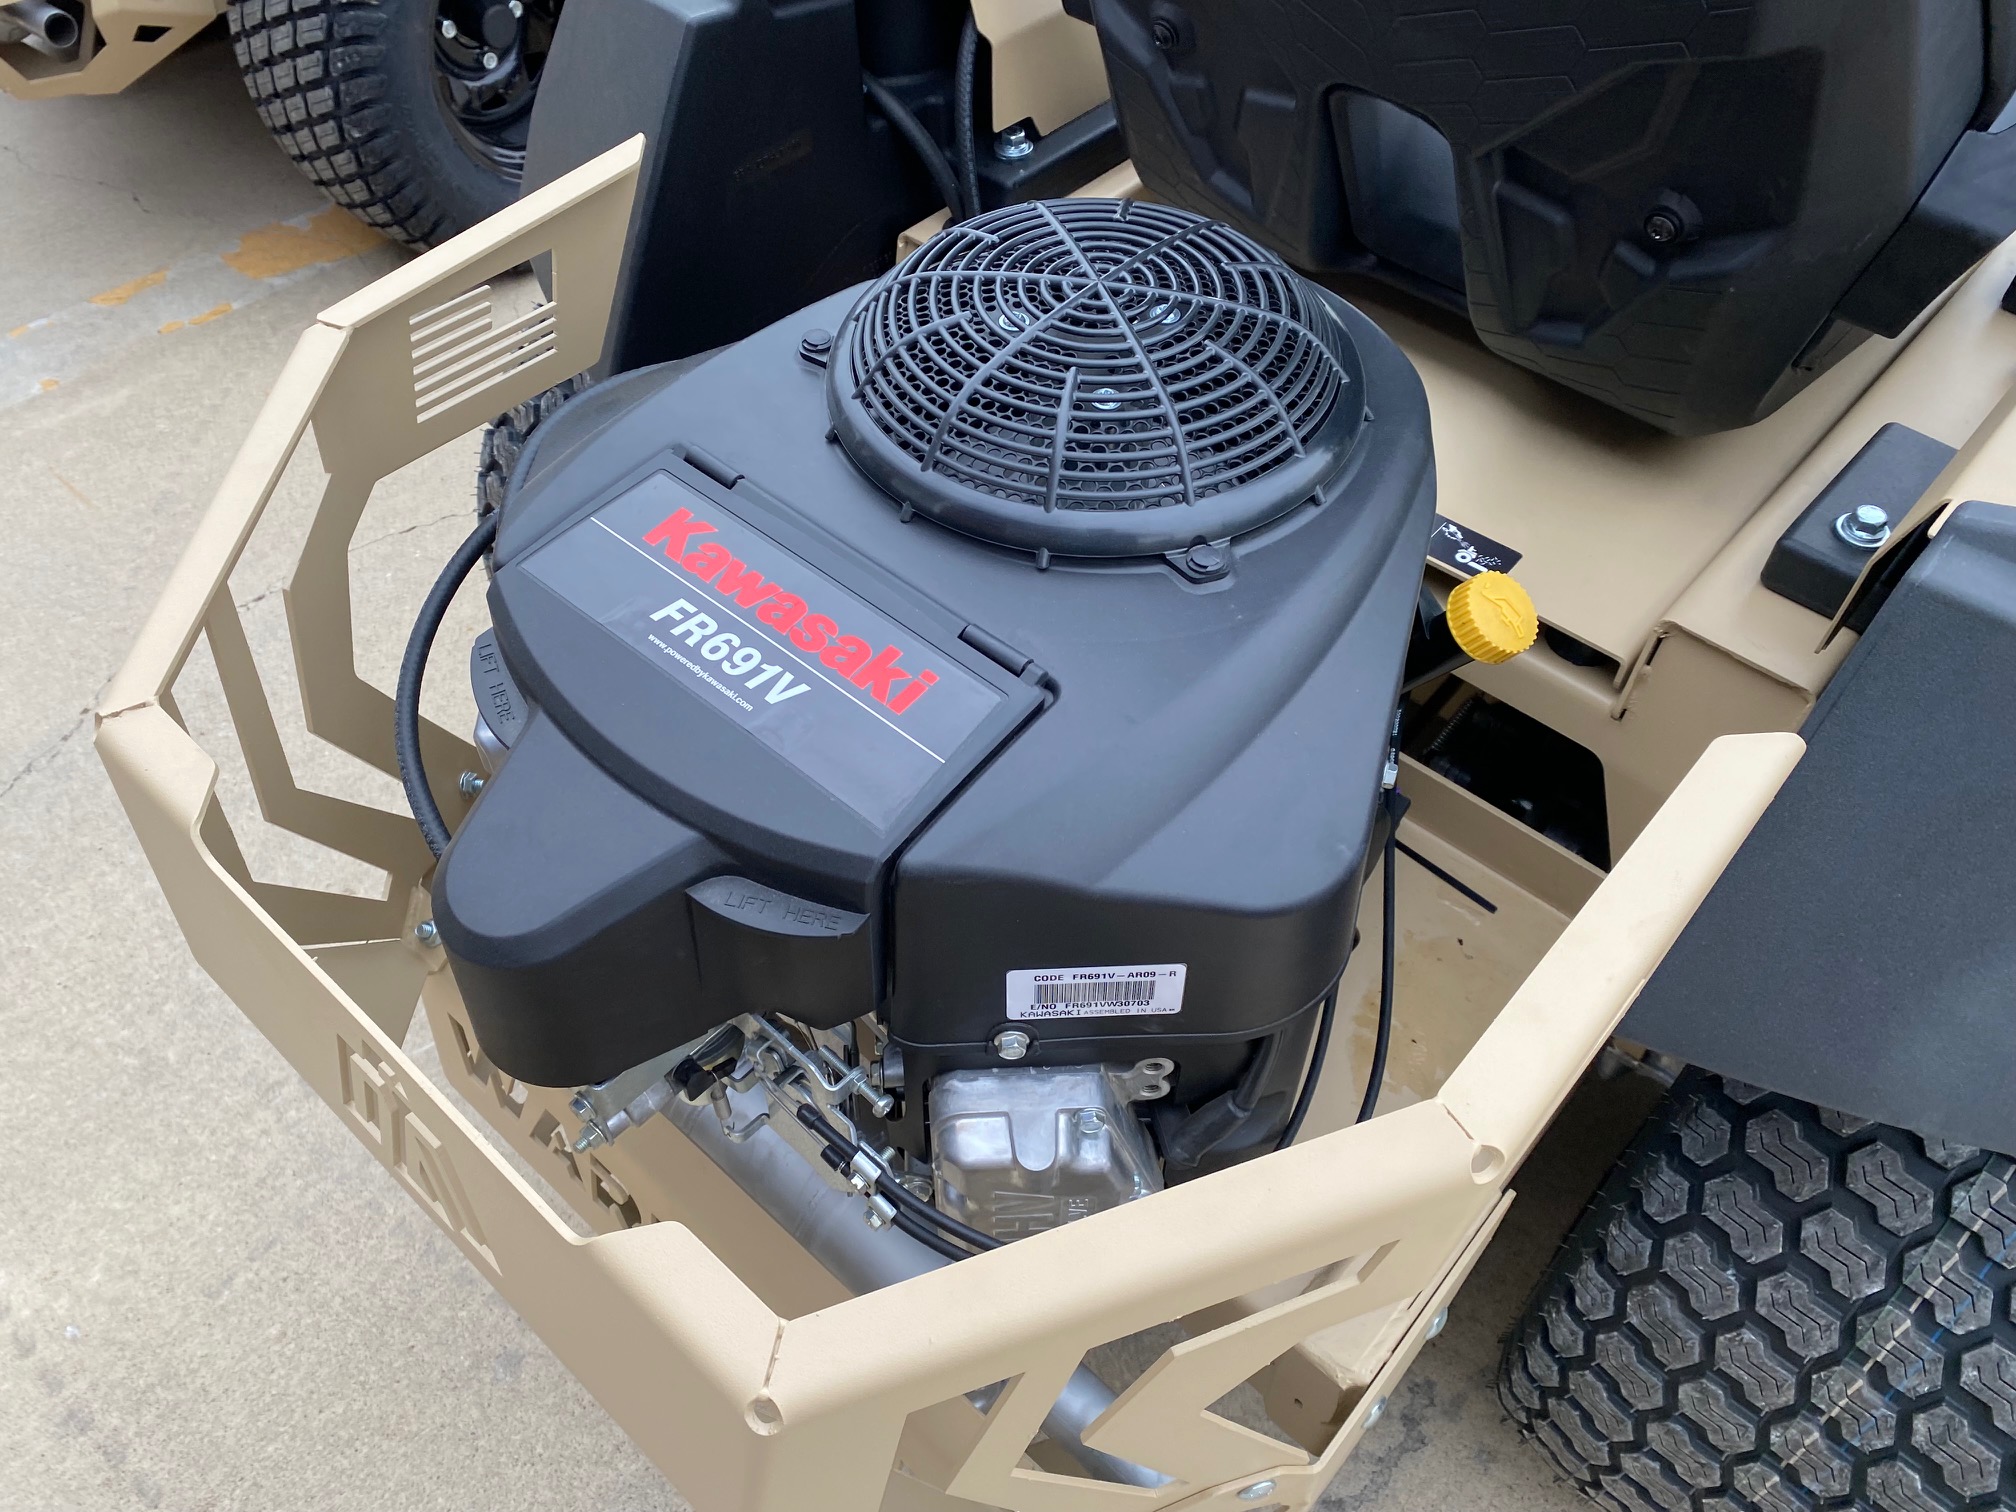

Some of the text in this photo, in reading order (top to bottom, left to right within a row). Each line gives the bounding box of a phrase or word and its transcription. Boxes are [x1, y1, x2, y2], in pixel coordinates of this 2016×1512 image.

[642, 507, 939, 716] Kawasaki
[648, 634, 753, 711] www.poweredbykawasaki.com
[649, 598, 811, 704] FR691V
[479, 643, 515, 724] LIFT HERE
[724, 891, 841, 930] LIFT HERE
[1030, 1003, 1057, 1011] E/NO
[1034, 974, 1065, 982] CODE
[1020, 1009, 1081, 1018] KAWASAKI
[1083, 1007, 1131, 1016] ASSEMBLED
